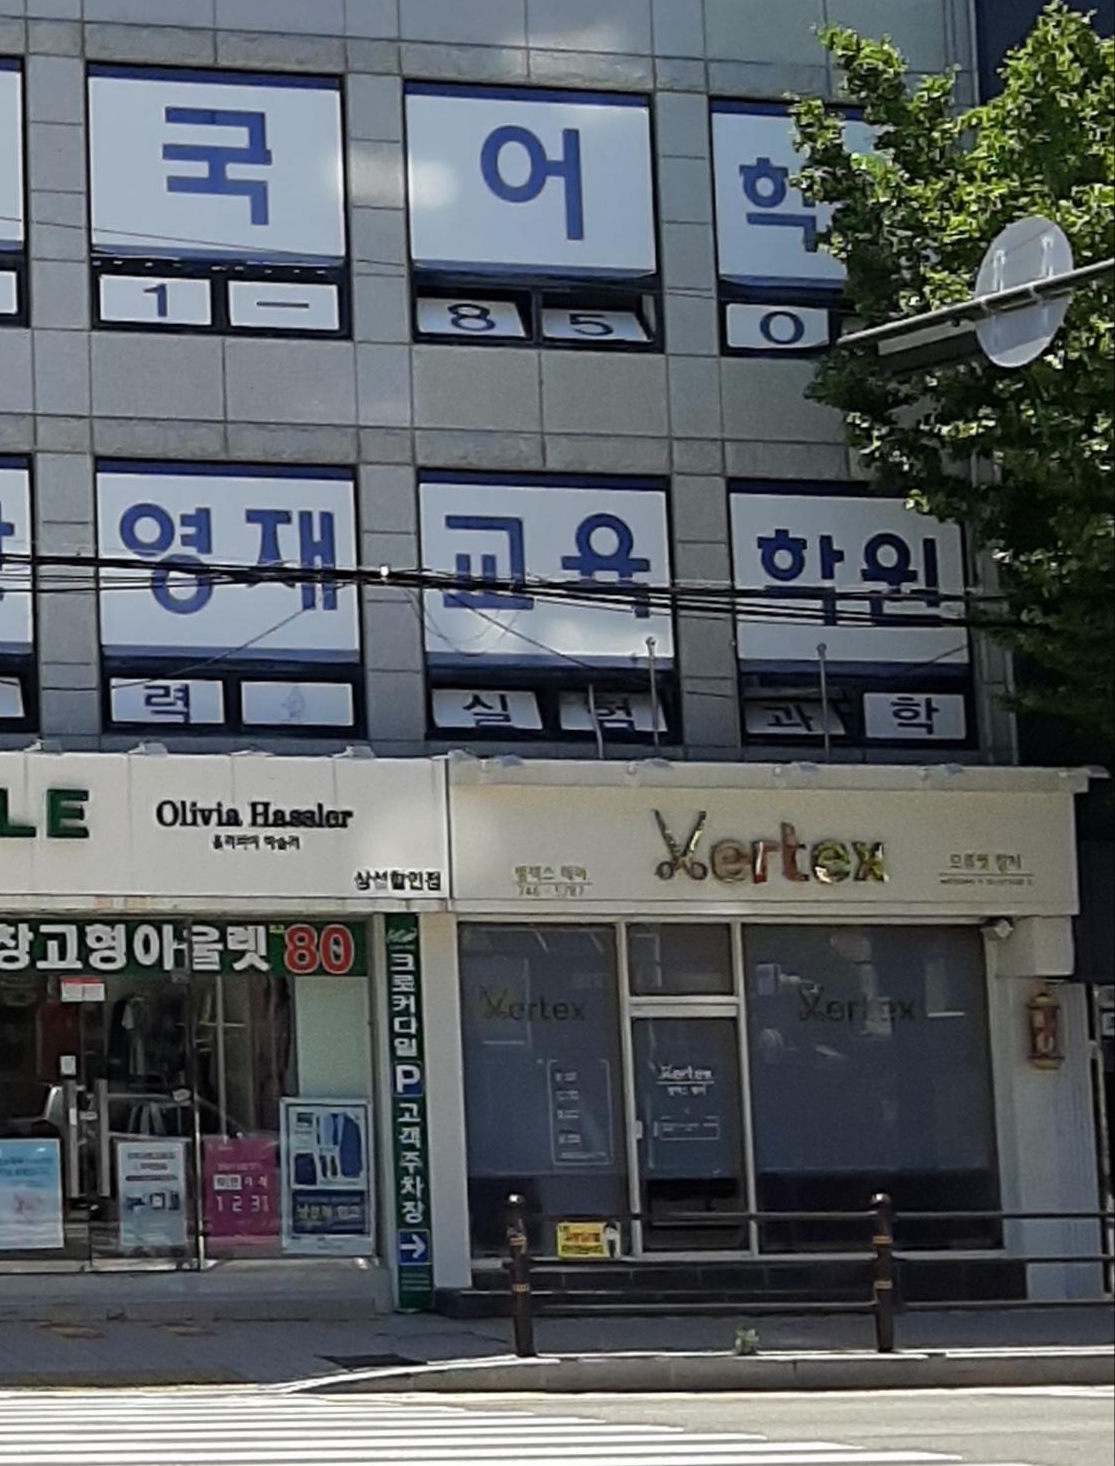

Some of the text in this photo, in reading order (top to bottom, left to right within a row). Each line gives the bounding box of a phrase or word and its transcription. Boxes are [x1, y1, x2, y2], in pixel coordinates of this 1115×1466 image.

[757, 528, 942, 627] 학원
[156, 800, 354, 829] Olivia Hassler
[390, 952, 418, 1057] 크로커다일
